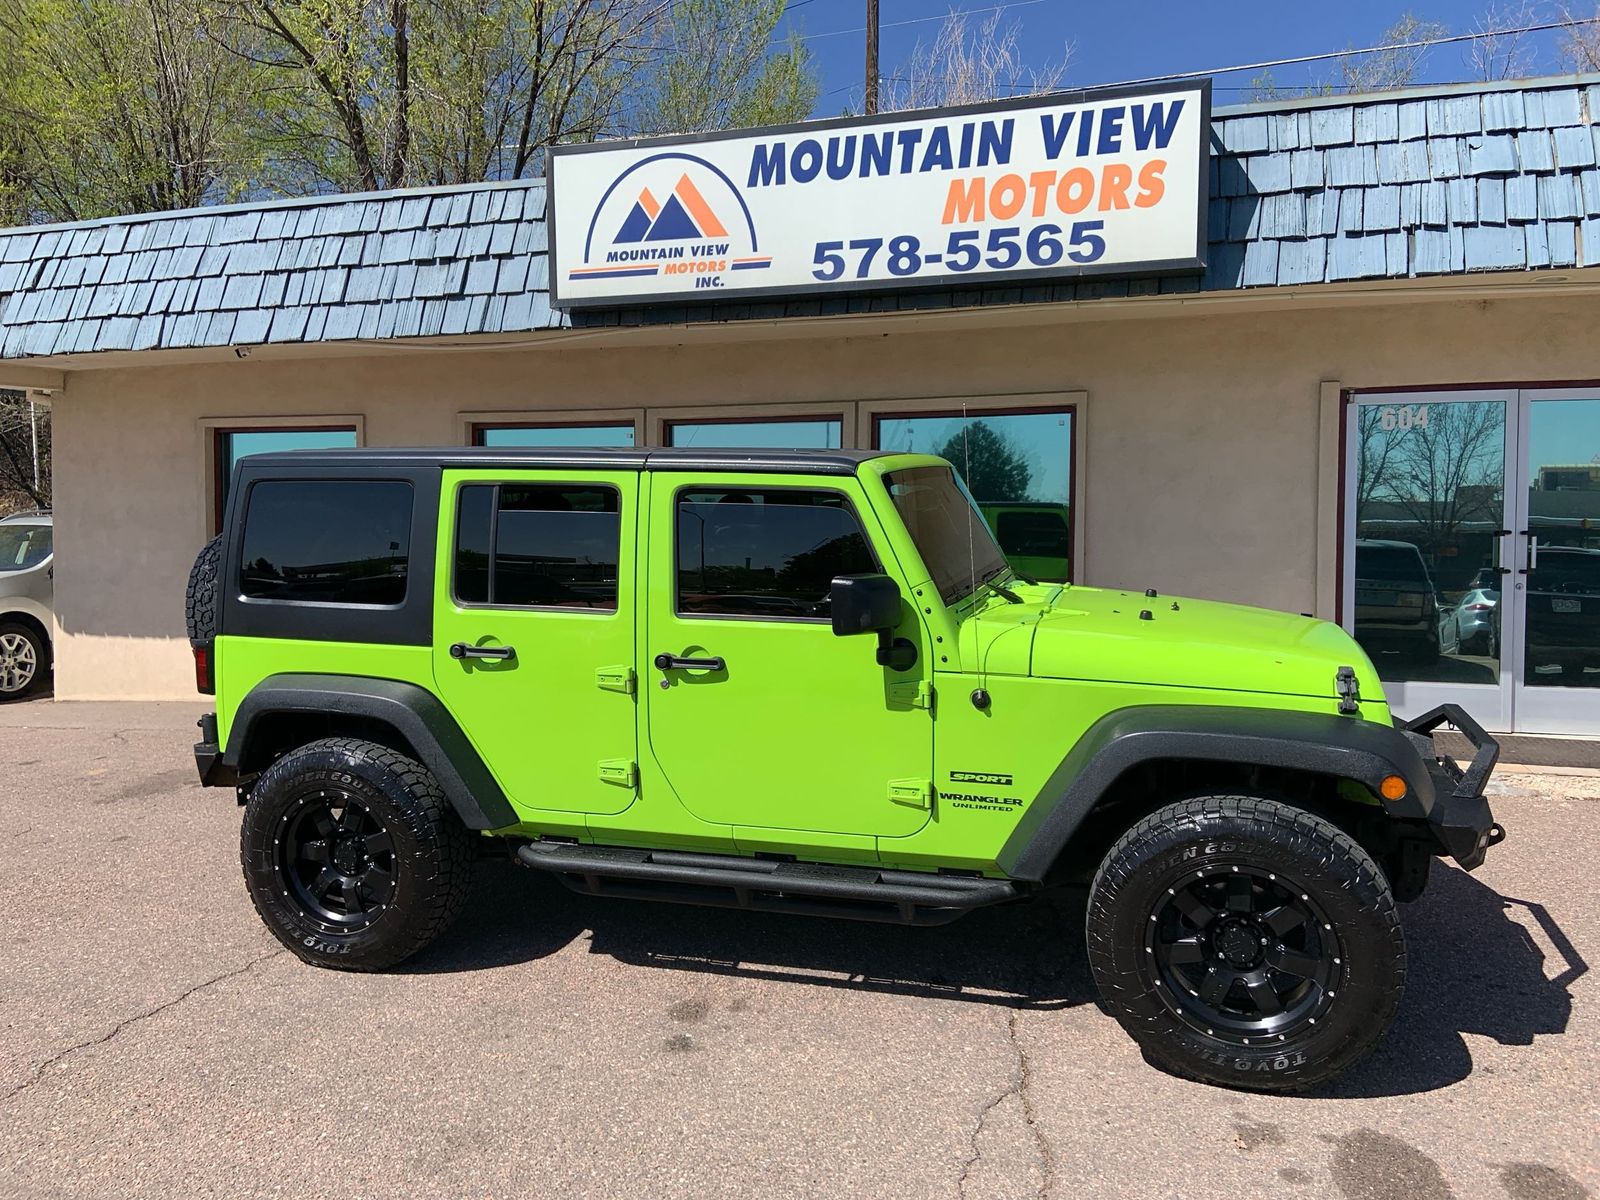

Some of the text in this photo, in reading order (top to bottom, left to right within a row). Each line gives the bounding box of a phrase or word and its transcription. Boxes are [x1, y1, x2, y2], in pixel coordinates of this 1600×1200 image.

[746, 99, 1186, 189] MOUNTAIN VIEW
[940, 158, 1168, 225] MOTORS
[606, 243, 730, 263] MOUNTAIN VIEW
[811, 219, 1106, 282] 578-5565
[663, 259, 727, 275] MOTORS
[695, 275, 725, 289] INC.
[1381, 406, 1428, 431] 604
[952, 773, 1009, 784] SPORT
[939, 792, 1024, 806] WRANGLER
[952, 802, 1014, 812] UNLIMITED
[302, 936, 352, 954] TOYO
[1233, 1051, 1308, 1073] TOYO
